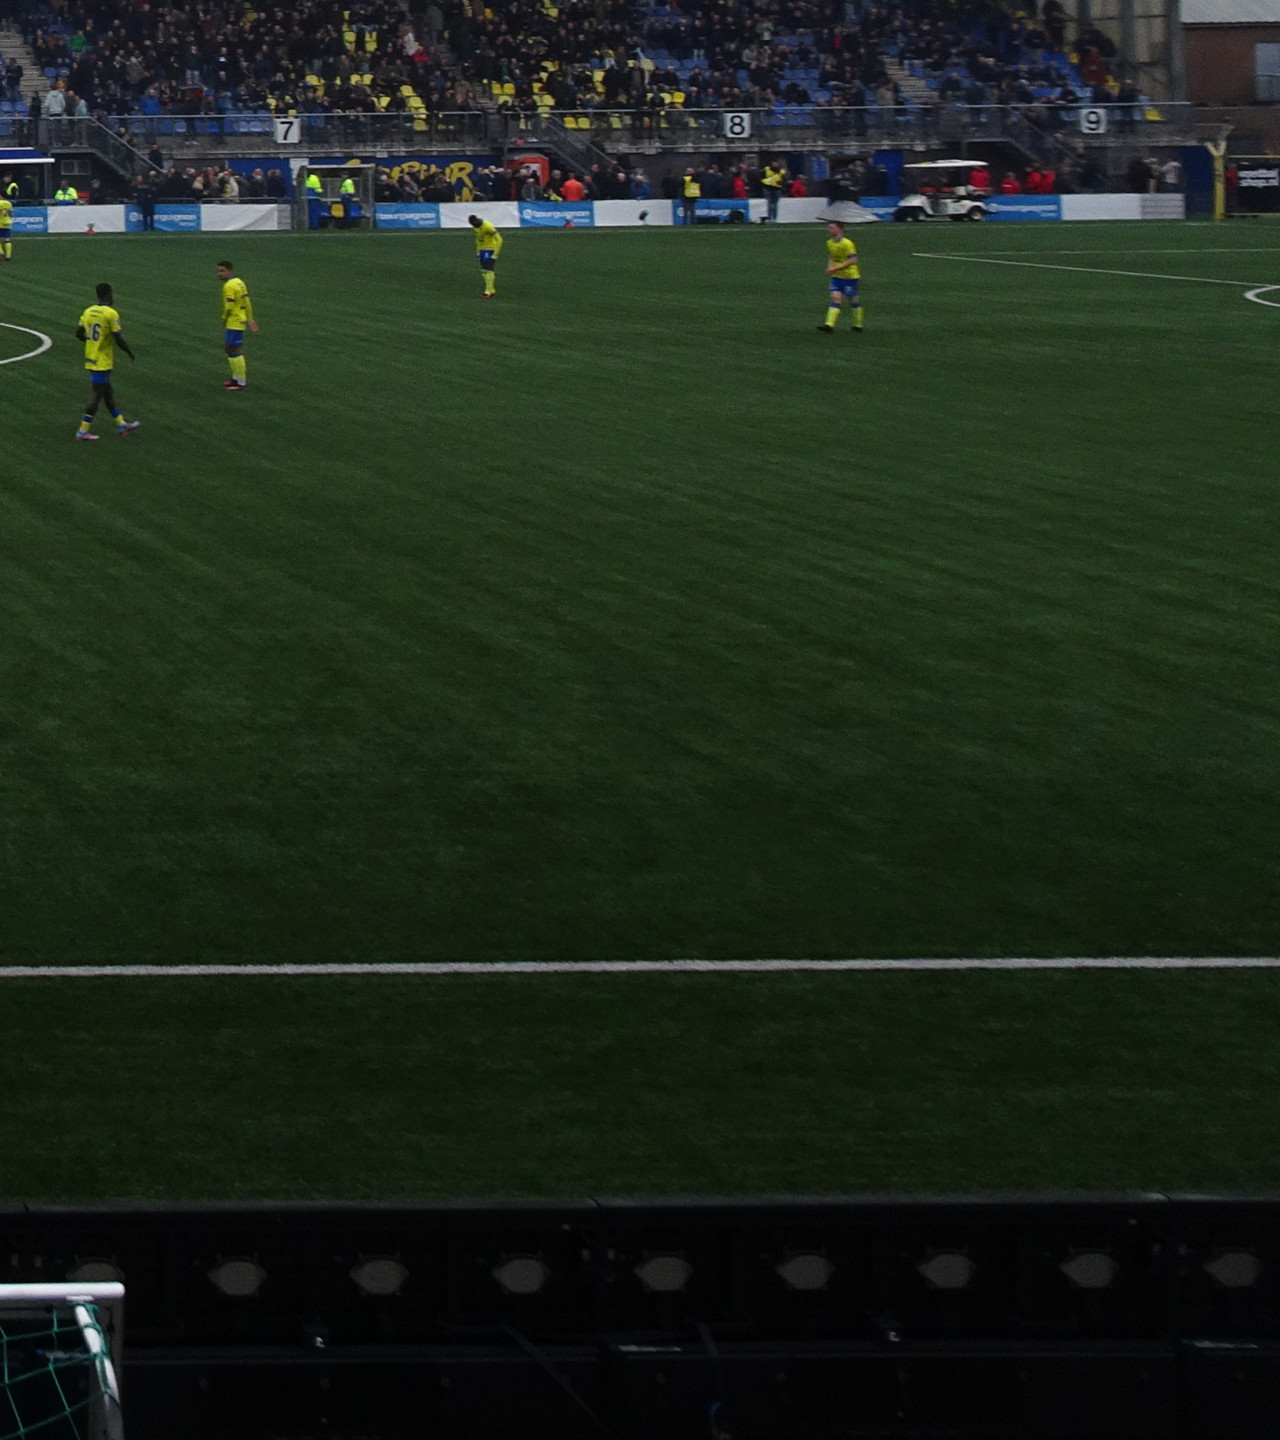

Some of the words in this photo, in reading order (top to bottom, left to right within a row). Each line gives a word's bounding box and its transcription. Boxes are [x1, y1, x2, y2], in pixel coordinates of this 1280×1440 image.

[280, 121, 294, 141] 7
[730, 115, 745, 135] 8
[1086, 111, 1101, 131] 9
